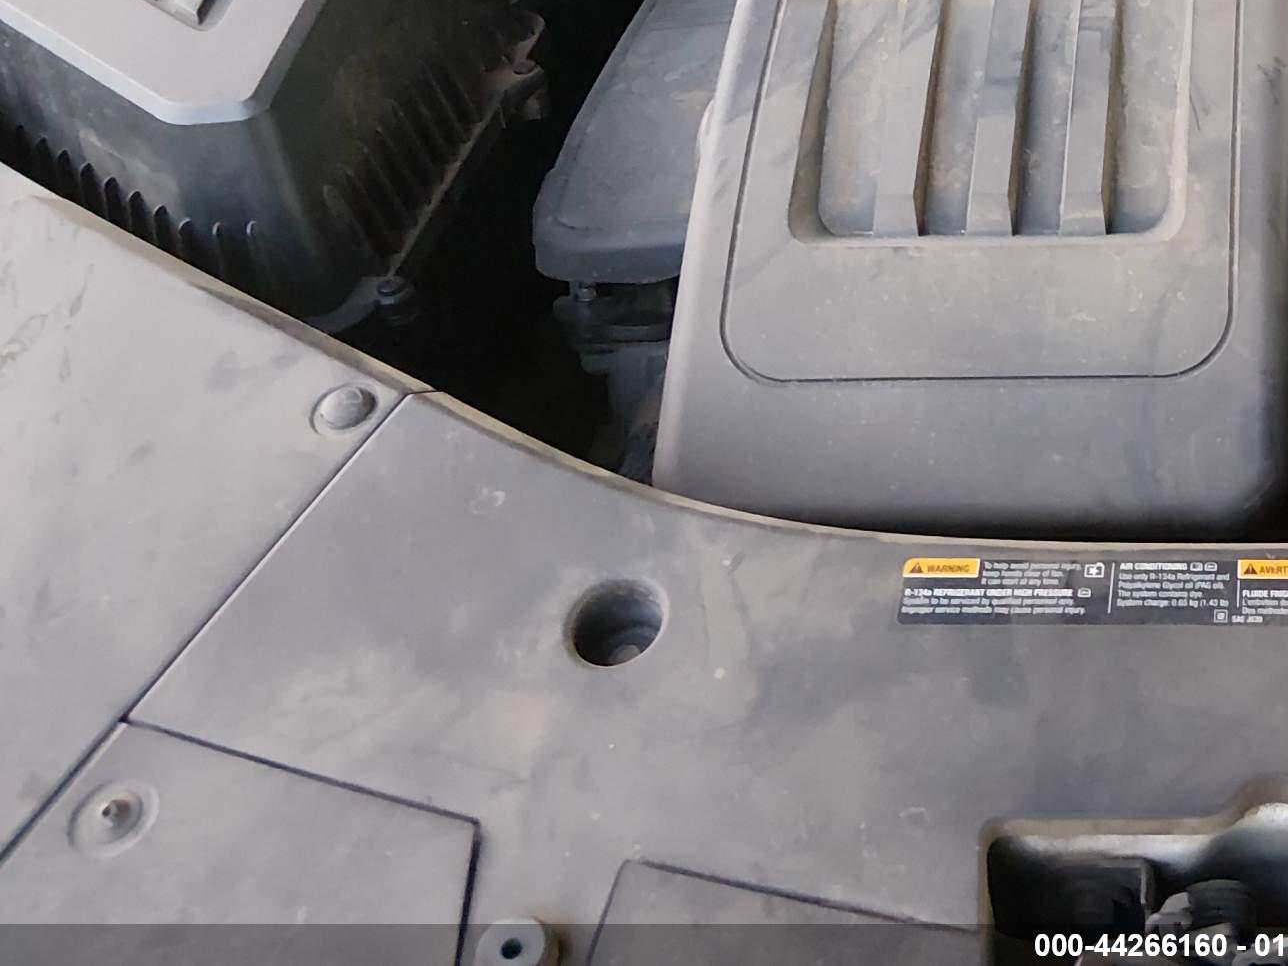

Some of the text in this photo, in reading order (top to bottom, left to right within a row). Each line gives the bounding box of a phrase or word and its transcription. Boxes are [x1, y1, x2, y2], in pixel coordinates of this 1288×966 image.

[927, 564, 969, 573] WARNING
[1034, 588, 1073, 597] PRESSURE
[1242, 590, 1269, 598] FLUIDE
